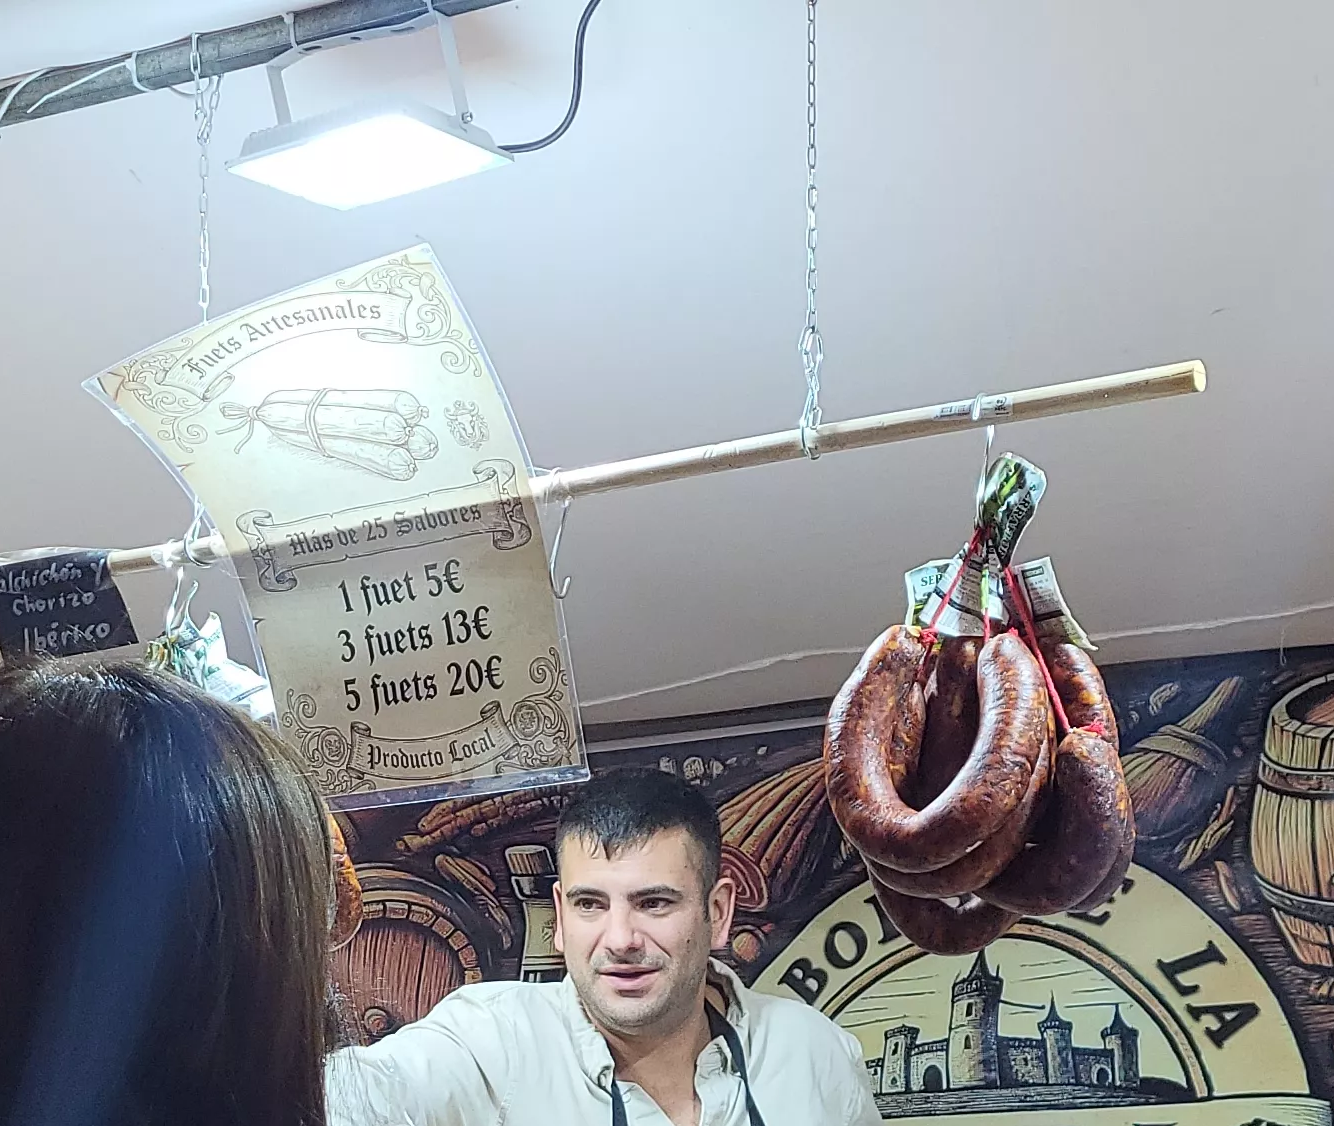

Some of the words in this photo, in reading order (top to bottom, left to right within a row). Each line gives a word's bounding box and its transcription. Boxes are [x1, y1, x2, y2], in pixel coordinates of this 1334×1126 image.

[181, 336, 243, 381] Fuets
[241, 298, 382, 347] Artesanales
[287, 529, 333, 557] Más
[337, 525, 360, 547] de
[362, 515, 388, 543] 25
[392, 501, 482, 538] Sabores
[338, 580, 353, 613] 1
[360, 571, 418, 616] fuet
[425, 558, 466, 598] 5€
[337, 630, 355, 663] 3
[364, 619, 433, 666] fuets
[441, 605, 493, 648] 13€
[344, 678, 360, 712] 5
[370, 670, 438, 716] fuets
[447, 655, 506, 697] 20€
[367, 737, 444, 771] Producto
[448, 726, 498, 763] Local
[1157, 940, 1263, 1050] LA
